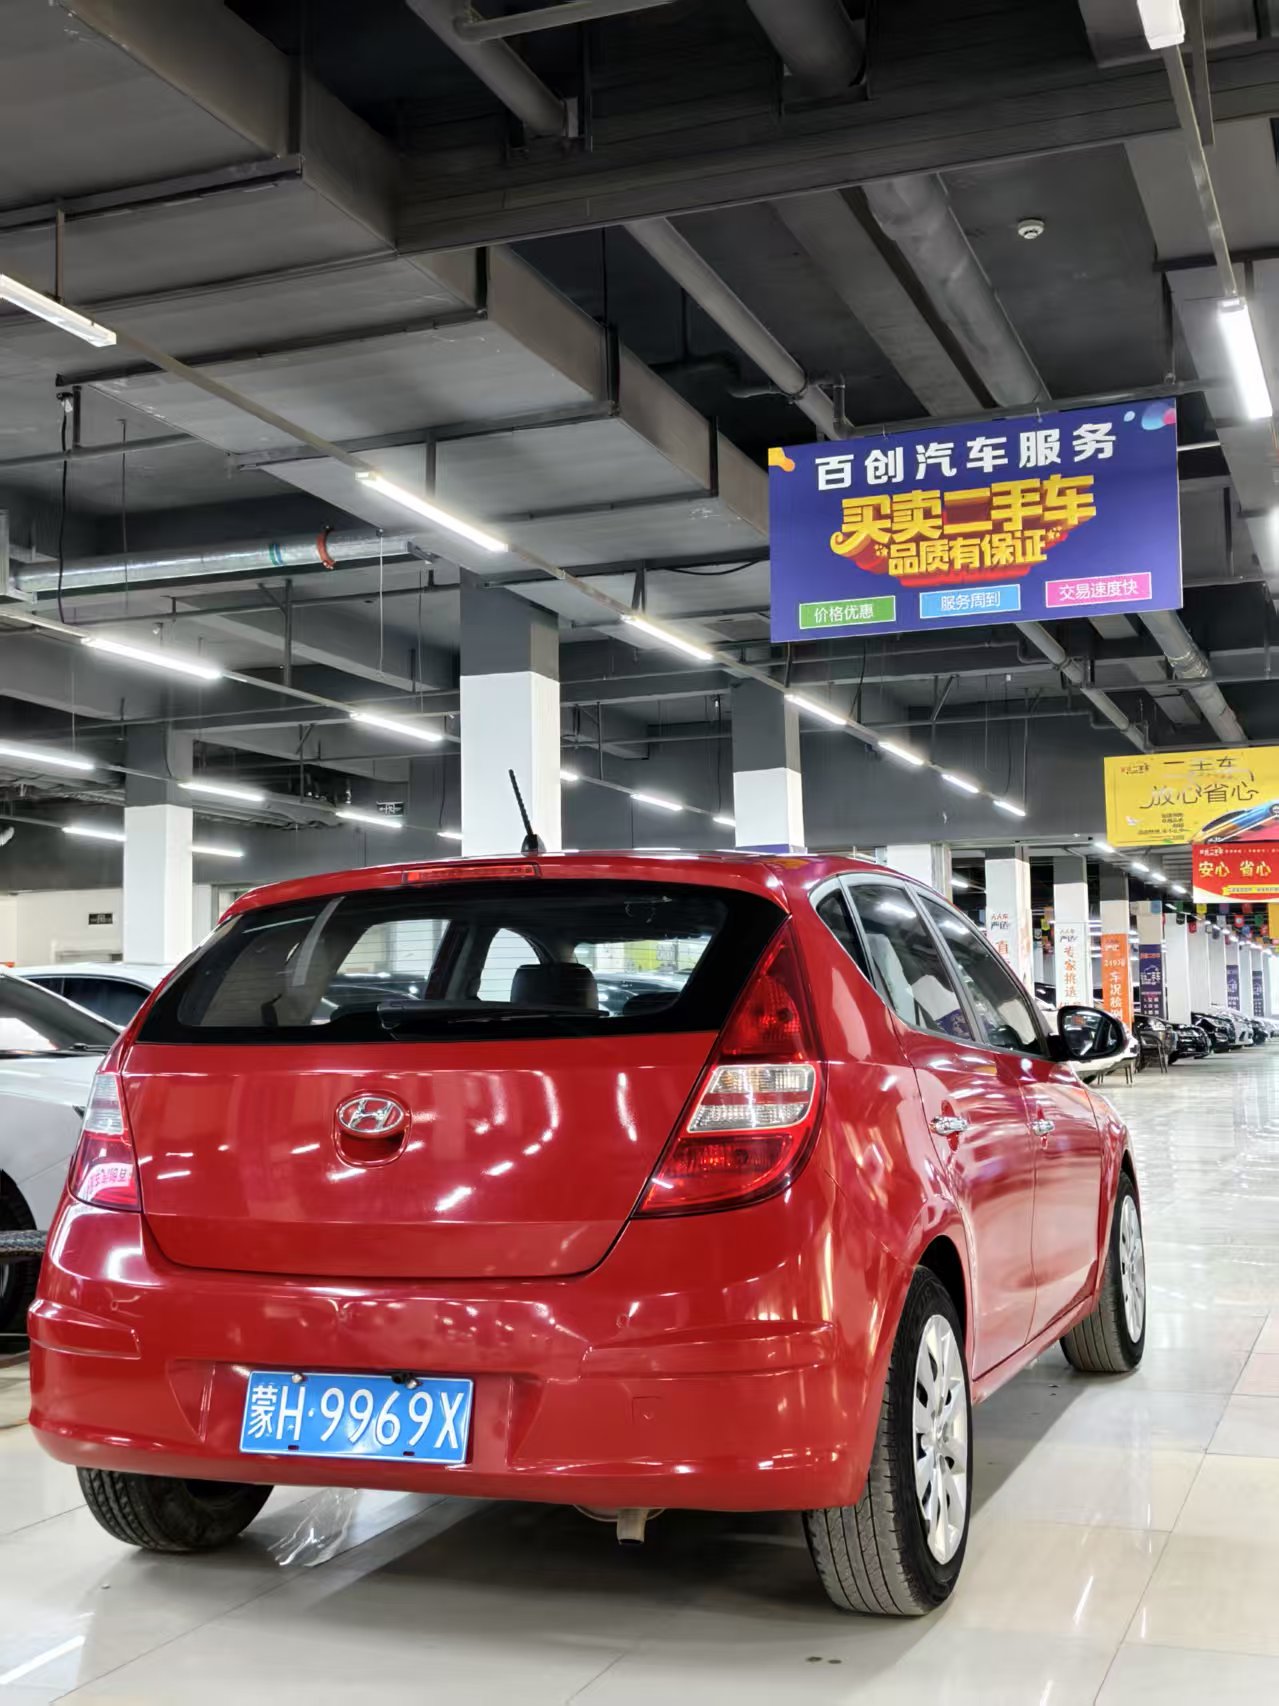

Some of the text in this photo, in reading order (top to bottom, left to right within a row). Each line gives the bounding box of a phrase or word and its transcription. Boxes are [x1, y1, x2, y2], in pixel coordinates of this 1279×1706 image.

[815, 422, 1116, 491] 百创汽车服务
[830, 474, 1097, 555] 买卖二手车
[888, 529, 1048, 576] 品质有保证
[940, 592, 1001, 612] 服务周到
[1058, 579, 1139, 602] 交易速度快
[814, 603, 874, 622] 价格优惠
[1139, 781, 1260, 809] 放心省心
[1199, 859, 1272, 878] 安心 省心
[247, 1384, 465, 1450] 蒙H·9969X
